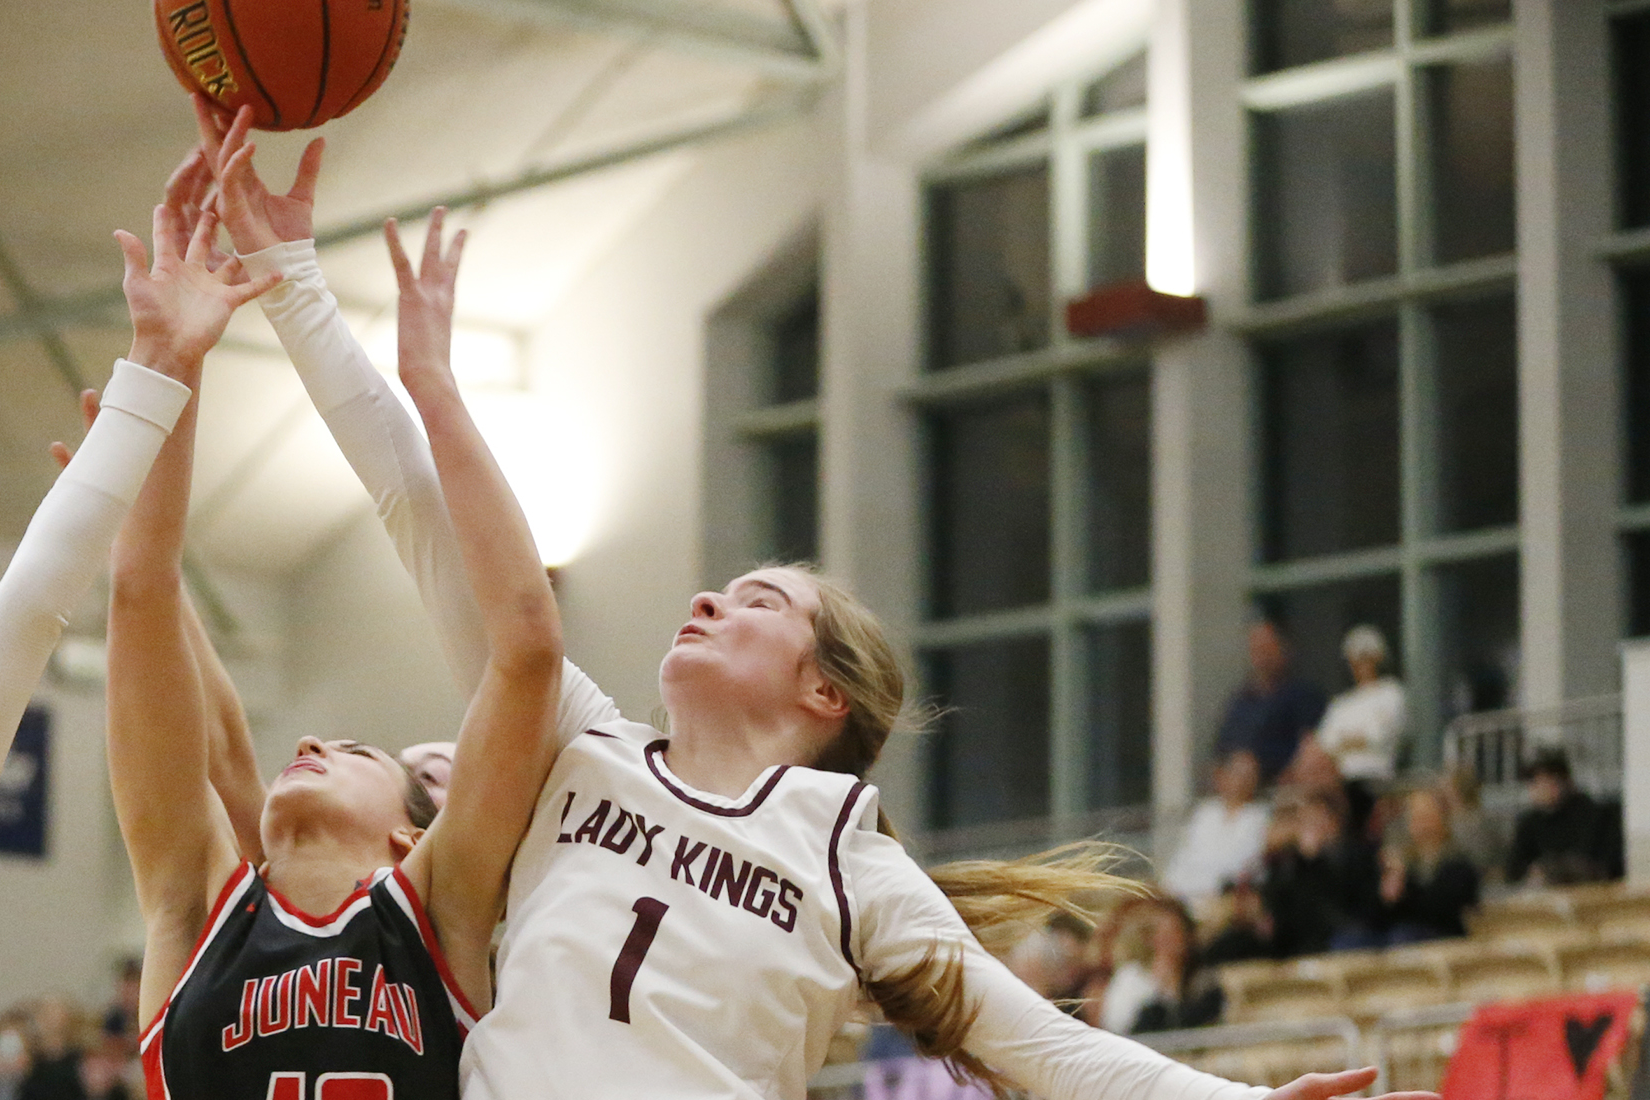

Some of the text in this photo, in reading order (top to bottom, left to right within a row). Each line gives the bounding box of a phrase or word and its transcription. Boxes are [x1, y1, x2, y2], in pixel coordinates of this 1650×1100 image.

[169, 0, 237, 97] ROCK
[556, 791, 804, 933] LADY KINGS
[222, 956, 424, 1056] JUNEAU
[608, 896, 670, 1025] 1
